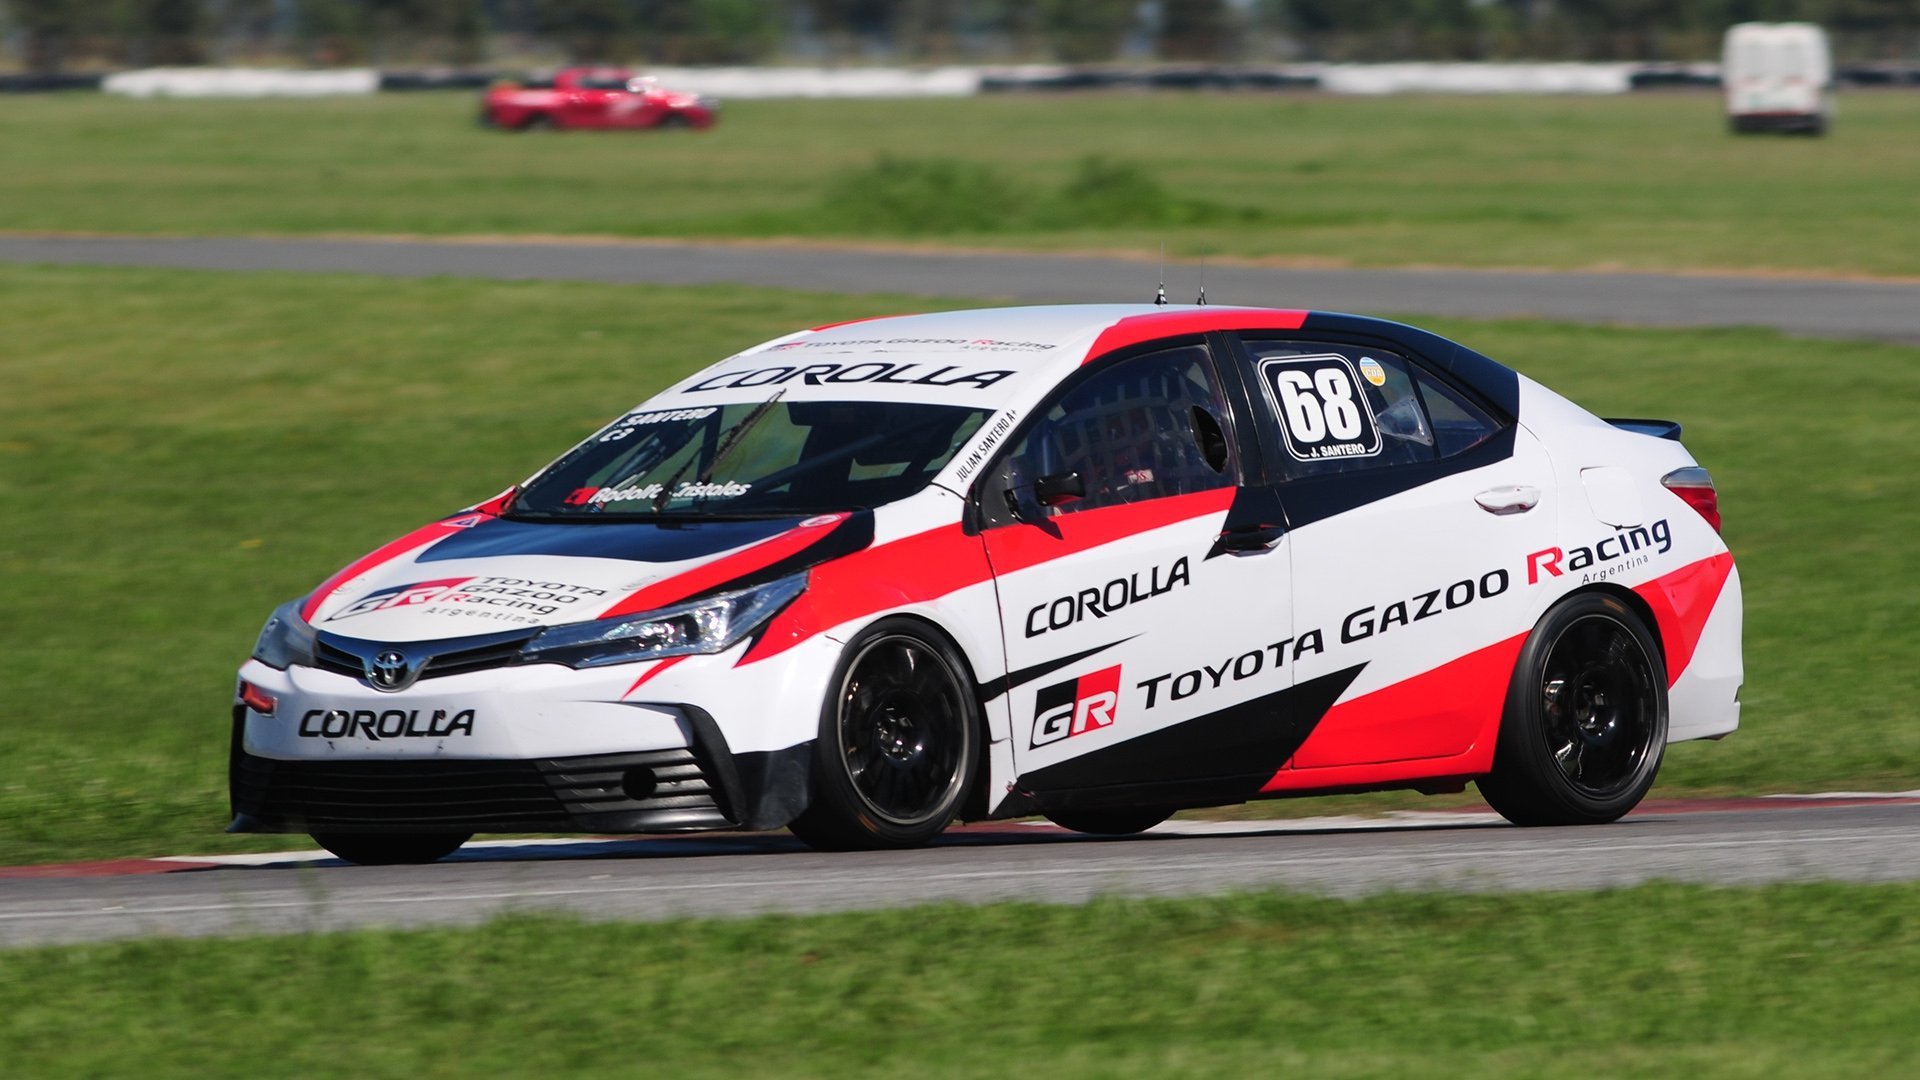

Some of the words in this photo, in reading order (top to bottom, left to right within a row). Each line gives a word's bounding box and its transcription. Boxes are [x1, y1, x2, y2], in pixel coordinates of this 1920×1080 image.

[681, 362, 1018, 394] COROLLA
[1277, 367, 1362, 443] 68
[956, 450, 983, 483] JULIAN
[979, 418, 1010, 456] SANTERO
[1310, 446, 1321, 458] J.
[1320, 443, 1366, 457] SANTERO
[1581, 554, 1649, 585] Argentina
[459, 584, 579, 604] GAZOO
[483, 576, 608, 597] TOYOTA
[1025, 555, 1190, 639] COROLLA
[423, 607, 540, 625] Argentina
[439, 593, 559, 616] Racing
[1136, 628, 1325, 710] TOYOTA
[1340, 568, 1509, 645] GAZOO
[1526, 518, 1672, 586] Racing
[298, 709, 476, 741] COROLLA
[1030, 688, 1119, 748] GR
